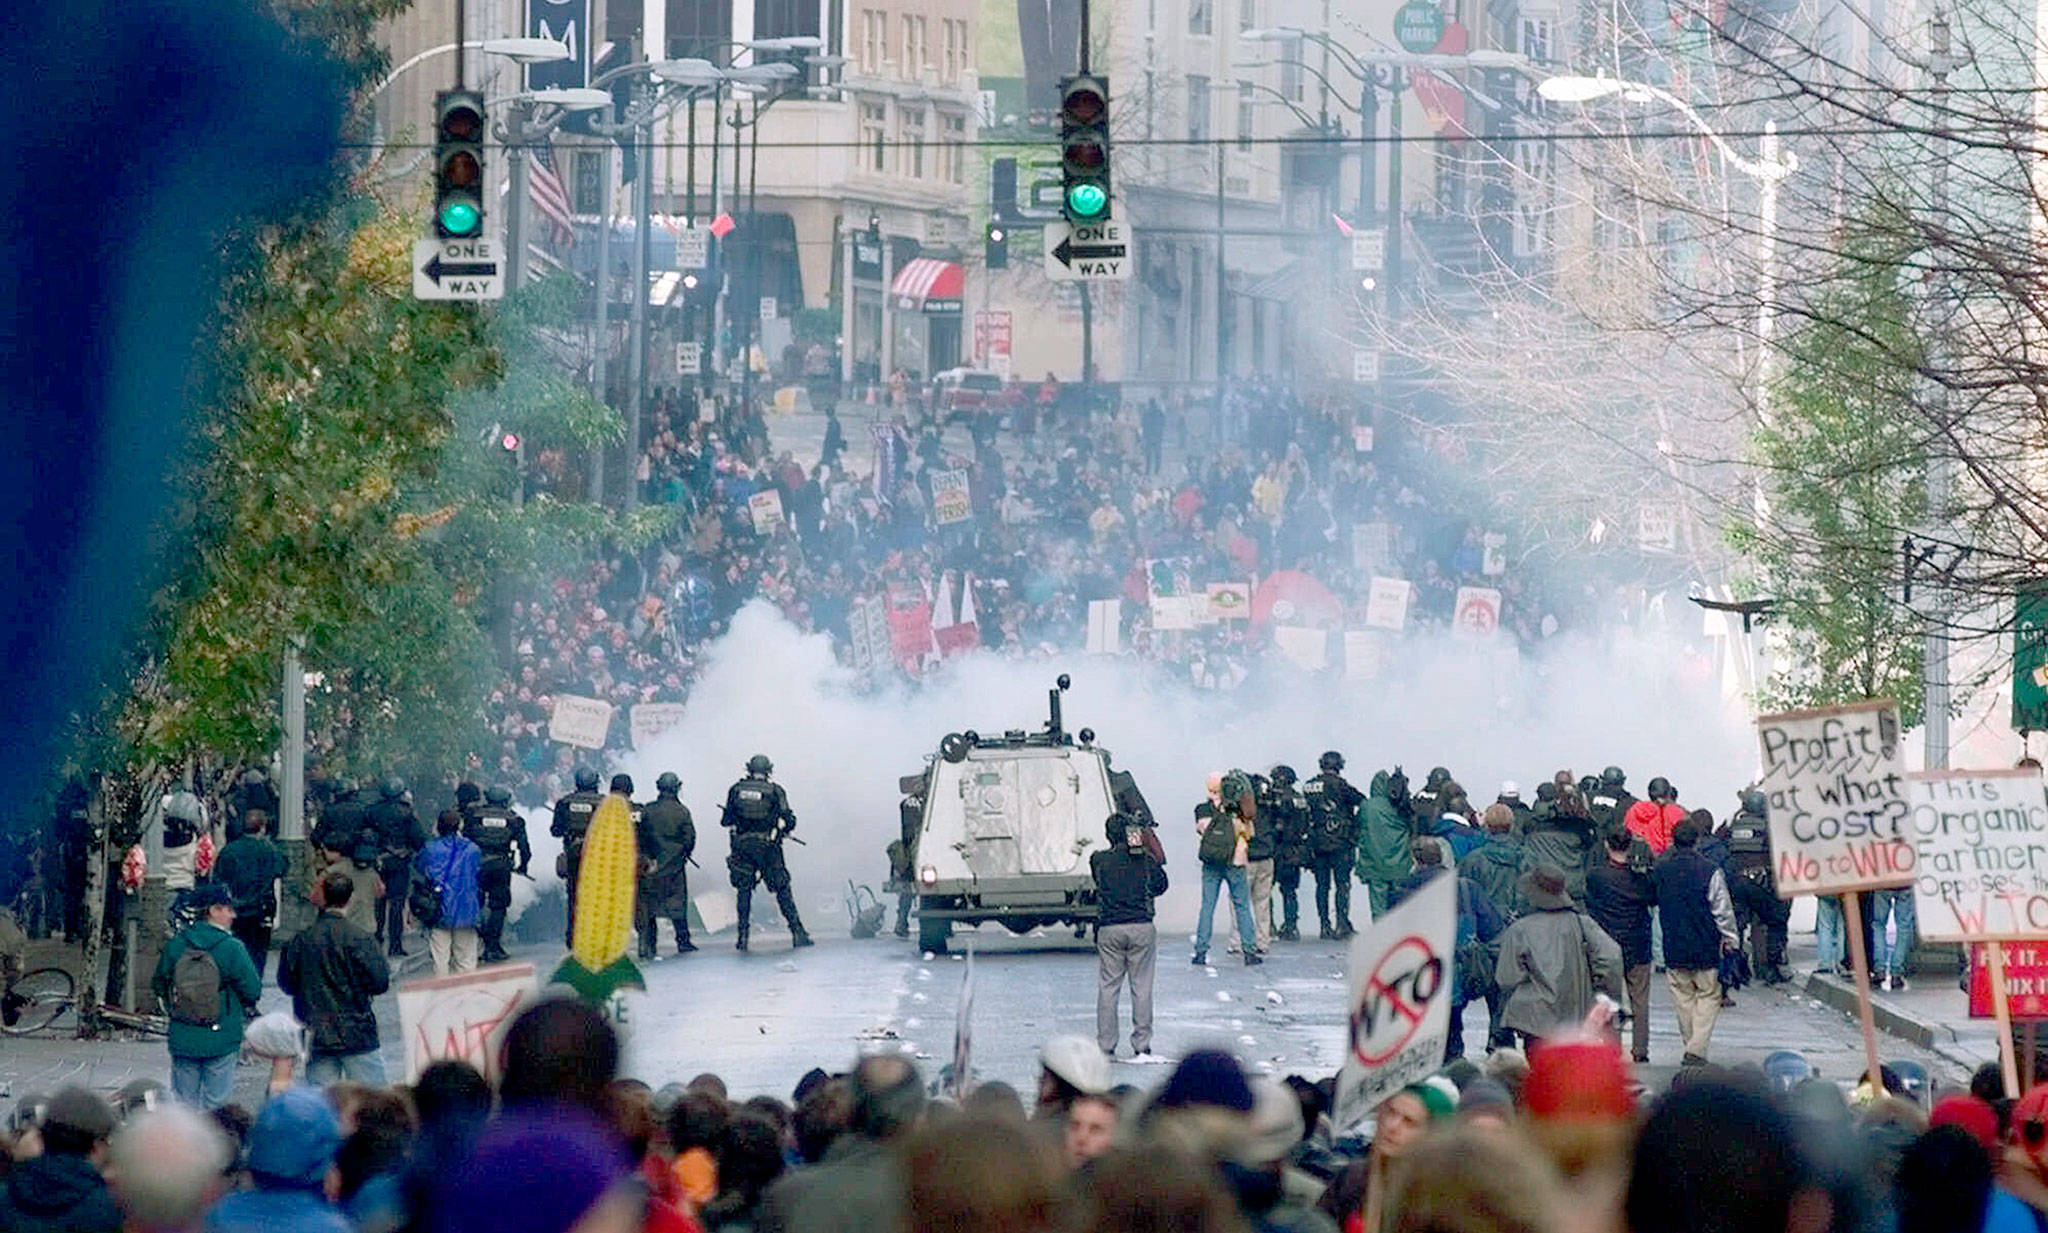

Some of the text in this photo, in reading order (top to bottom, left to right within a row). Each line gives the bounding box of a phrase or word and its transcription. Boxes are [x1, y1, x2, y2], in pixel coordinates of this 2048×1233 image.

[1076, 227, 1119, 240] ONE
[446, 244, 490, 258] ONE
[1079, 262, 1119, 275] WAY
[448, 281, 490, 294] WAY
[1763, 708, 1898, 766] Profit!
[1770, 784, 1803, 812] at
[1921, 780, 2000, 801] This
[1914, 802, 2046, 847] Organic
[1779, 839, 1916, 882] No to WTO
[1917, 838, 2047, 873] Farmer
[1919, 868, 2048, 903] Opposes th
[1949, 893, 2048, 934] WTO
[1980, 949, 2013, 967] FX
[2039, 978, 2048, 995] I
[1351, 956, 1443, 1053] WTO
